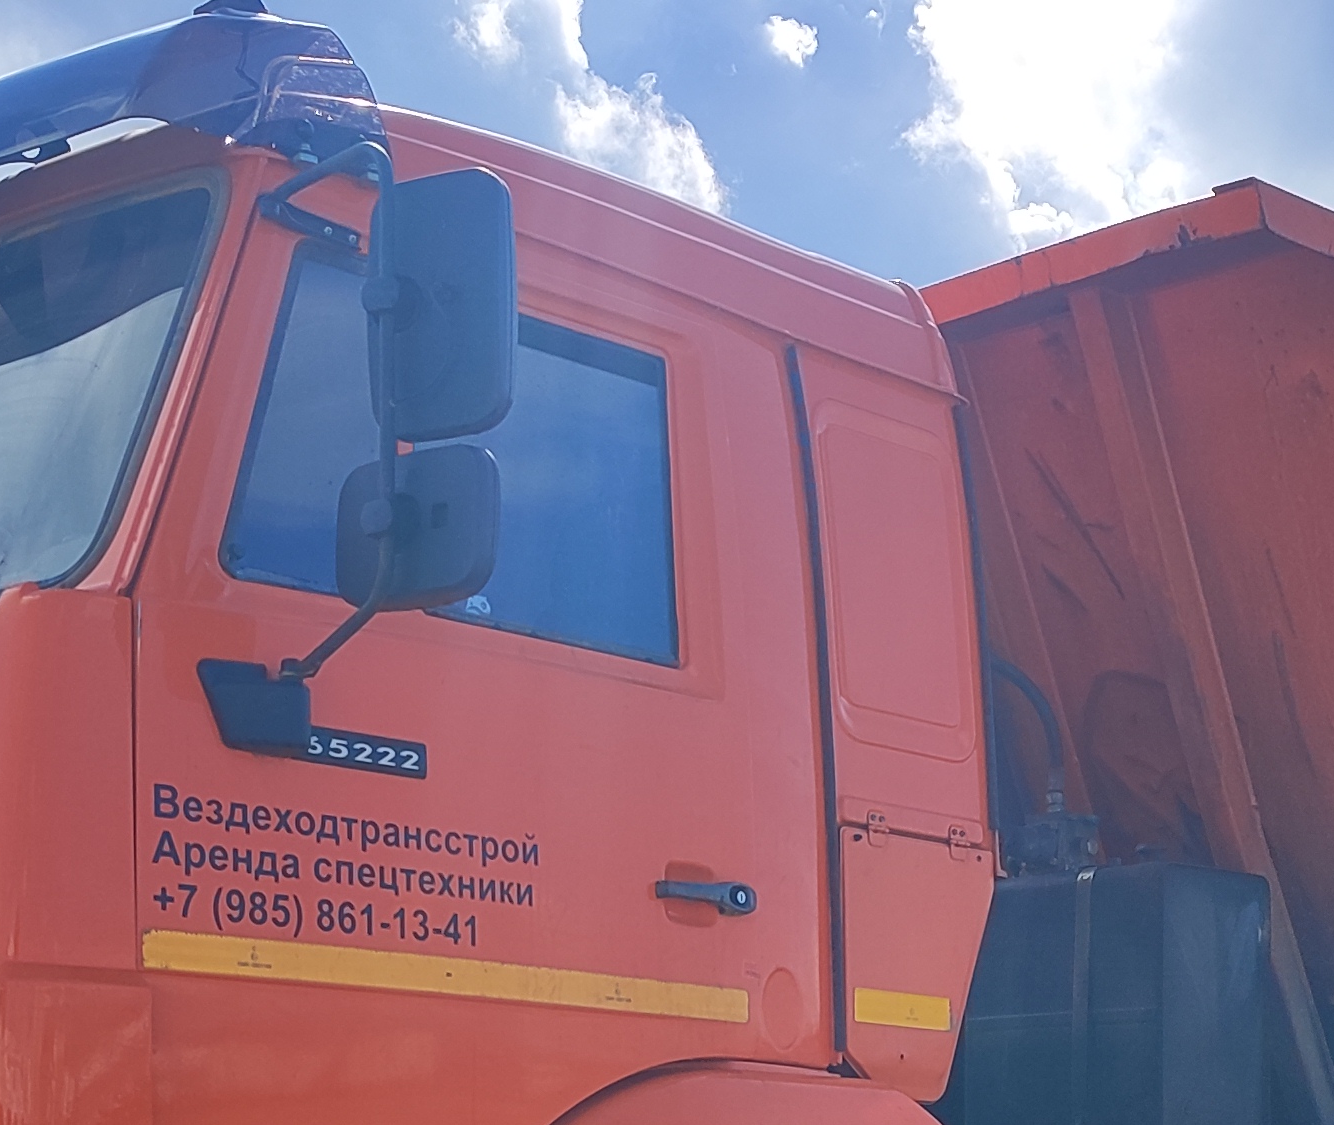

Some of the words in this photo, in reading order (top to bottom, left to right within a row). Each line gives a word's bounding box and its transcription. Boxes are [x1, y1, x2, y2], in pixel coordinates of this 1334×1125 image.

[308, 735, 420, 770] 65222
[153, 783, 539, 867] Вездеходтрансстрой
[152, 830, 301, 883] Аренда
[313, 856, 534, 907] спецтехники
[153, 883, 199, 918] +7
[212, 887, 304, 938] (985)
[317, 898, 478, 947] 861-13-41
